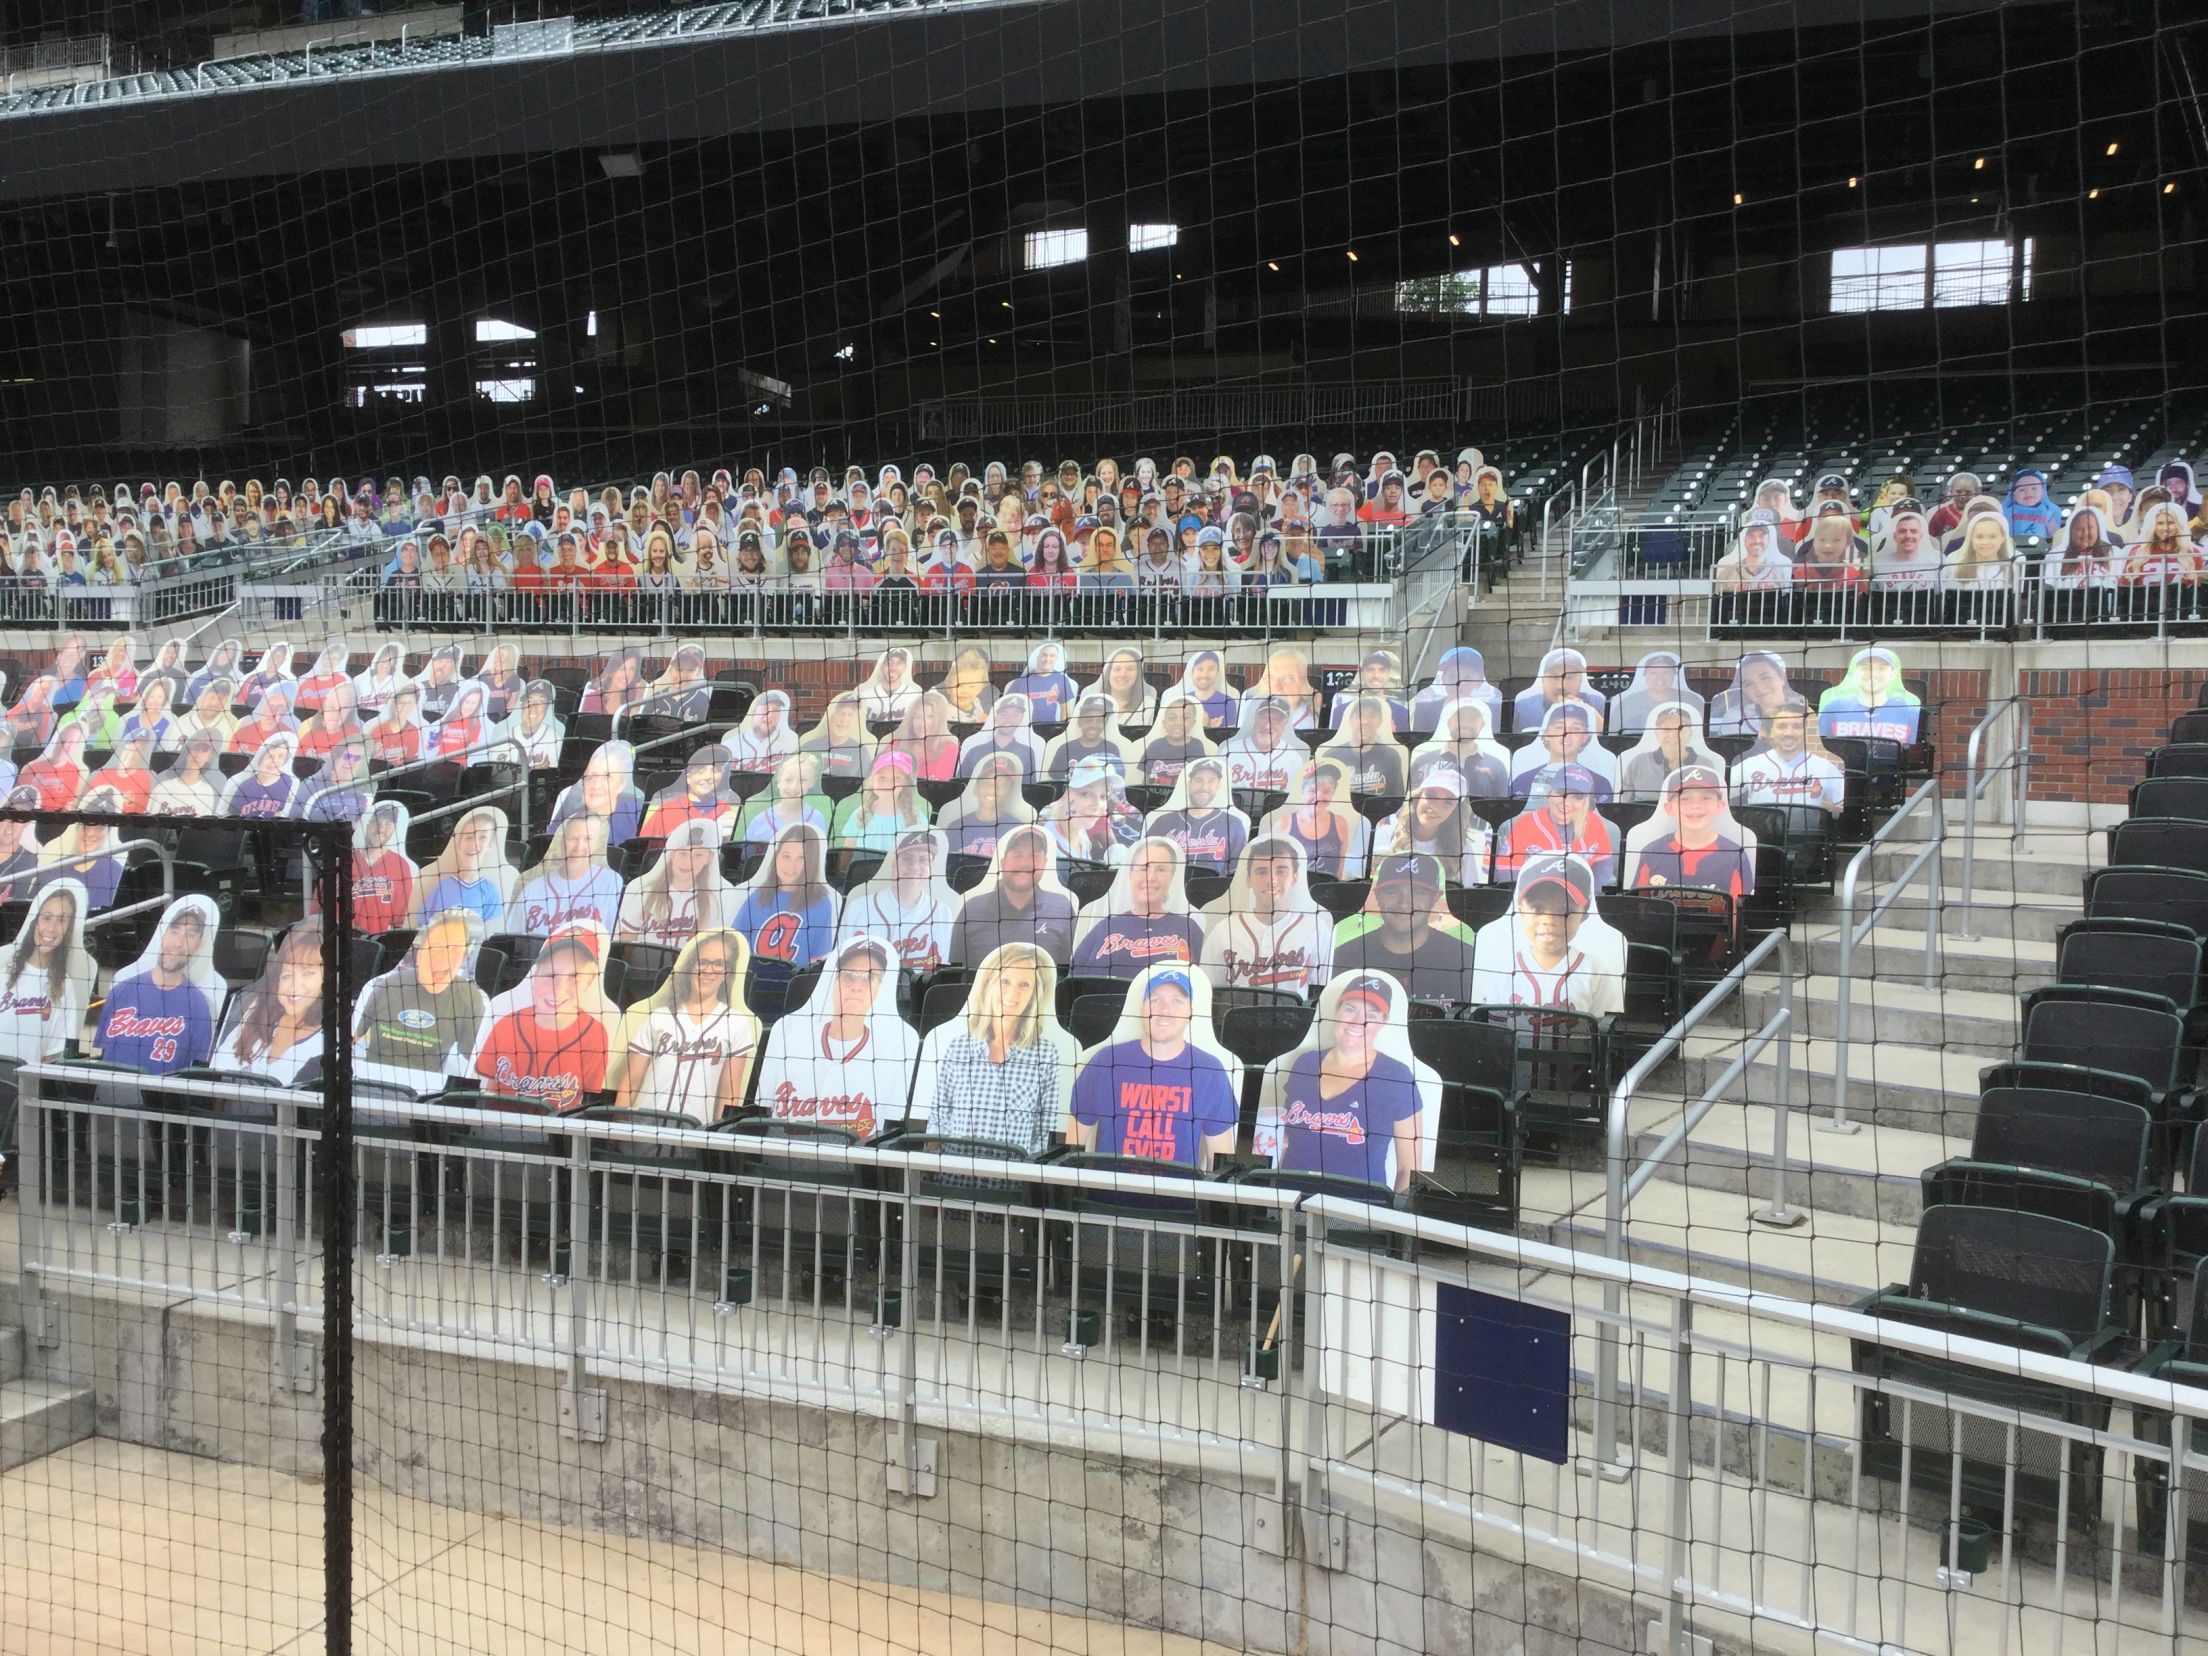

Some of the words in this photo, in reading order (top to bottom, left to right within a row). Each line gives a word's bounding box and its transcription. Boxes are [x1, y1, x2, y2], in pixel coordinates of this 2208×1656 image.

[1836, 721, 1909, 741] BRAVES
[1232, 764, 1285, 787] Braves
[1681, 768, 1703, 783] A
[1750, 771, 1814, 793] Braves
[1396, 857, 1419, 874] A
[1540, 859, 1566, 873] A
[526, 903, 592, 933] Braves
[1035, 922, 1048, 934] A
[1096, 933, 1179, 960] Braves
[1223, 946, 1305, 985] Braves
[1359, 979, 1380, 990] A
[0, 991, 47, 1014] Braves
[106, 1006, 185, 1038] Braves
[150, 1037, 178, 1063] 29
[656, 1031, 718, 1057] Braves
[496, 1056, 573, 1096] Braves
[774, 1080, 864, 1118] Braves
[1120, 1082, 1191, 1112] WORST
[1126, 1110, 1176, 1140] CALL
[1281, 1100, 1352, 1128] Braves
[1123, 1138, 1176, 1161] EVER
